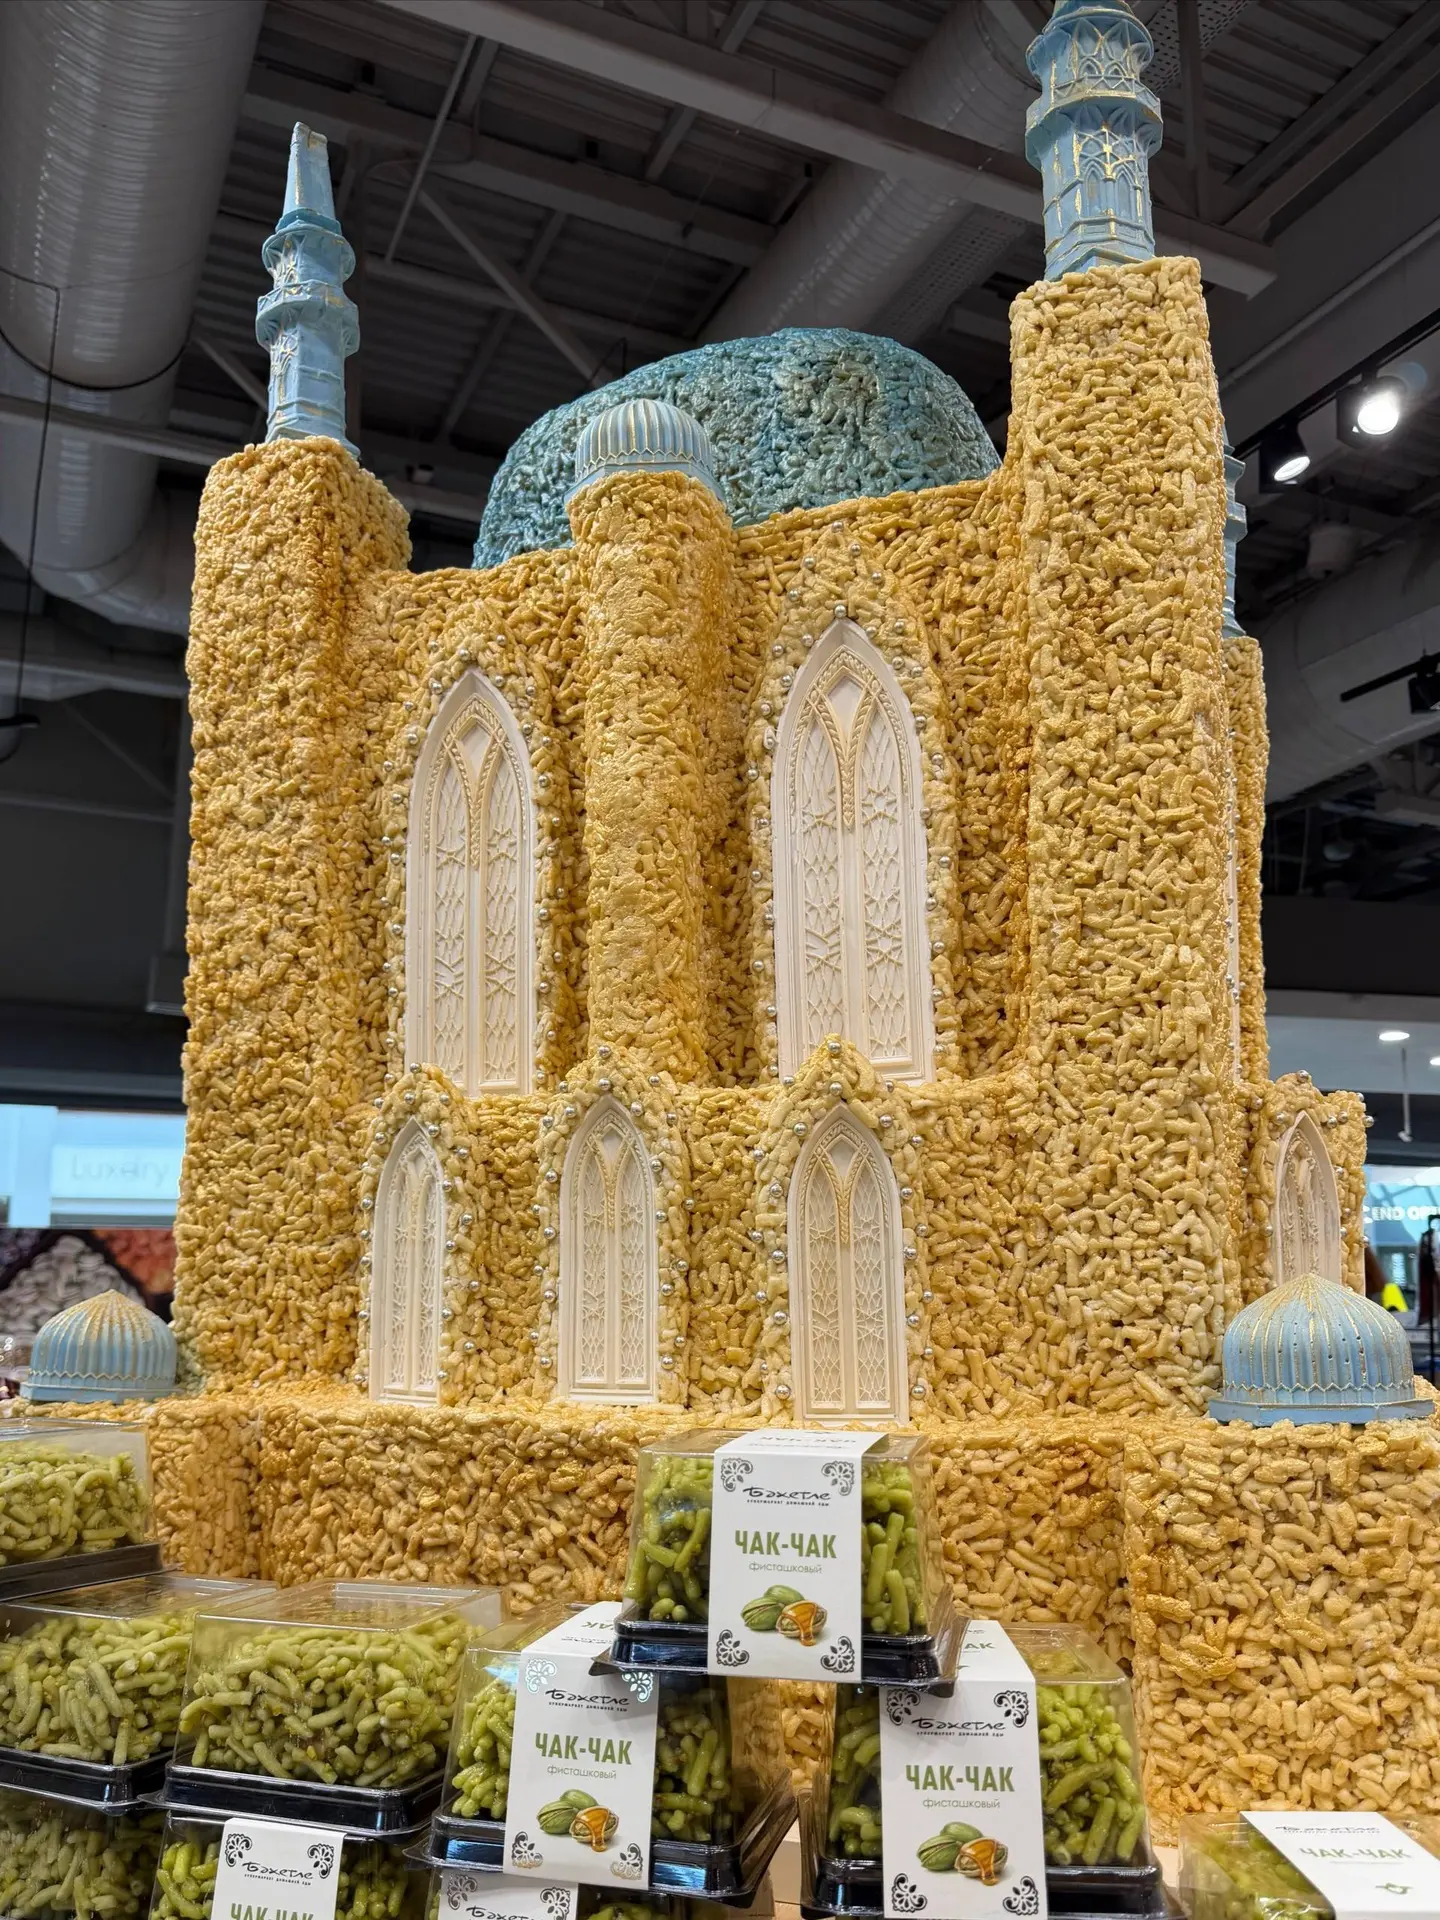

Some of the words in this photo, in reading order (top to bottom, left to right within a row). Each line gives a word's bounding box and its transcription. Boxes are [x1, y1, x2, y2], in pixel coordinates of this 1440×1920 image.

[735, 1530, 837, 1559] ЧАК-ЧАК
[749, 1561, 822, 1573] фисташковый
[535, 1732, 632, 1765] ЧАК-ЧАК
[547, 1765, 616, 1779] фисташковый
[905, 1764, 1015, 1792] ЧАК-ЧАК
[922, 1797, 1000, 1809] фисташковый
[1298, 1847, 1412, 1858] ЧАК-ЧАК
